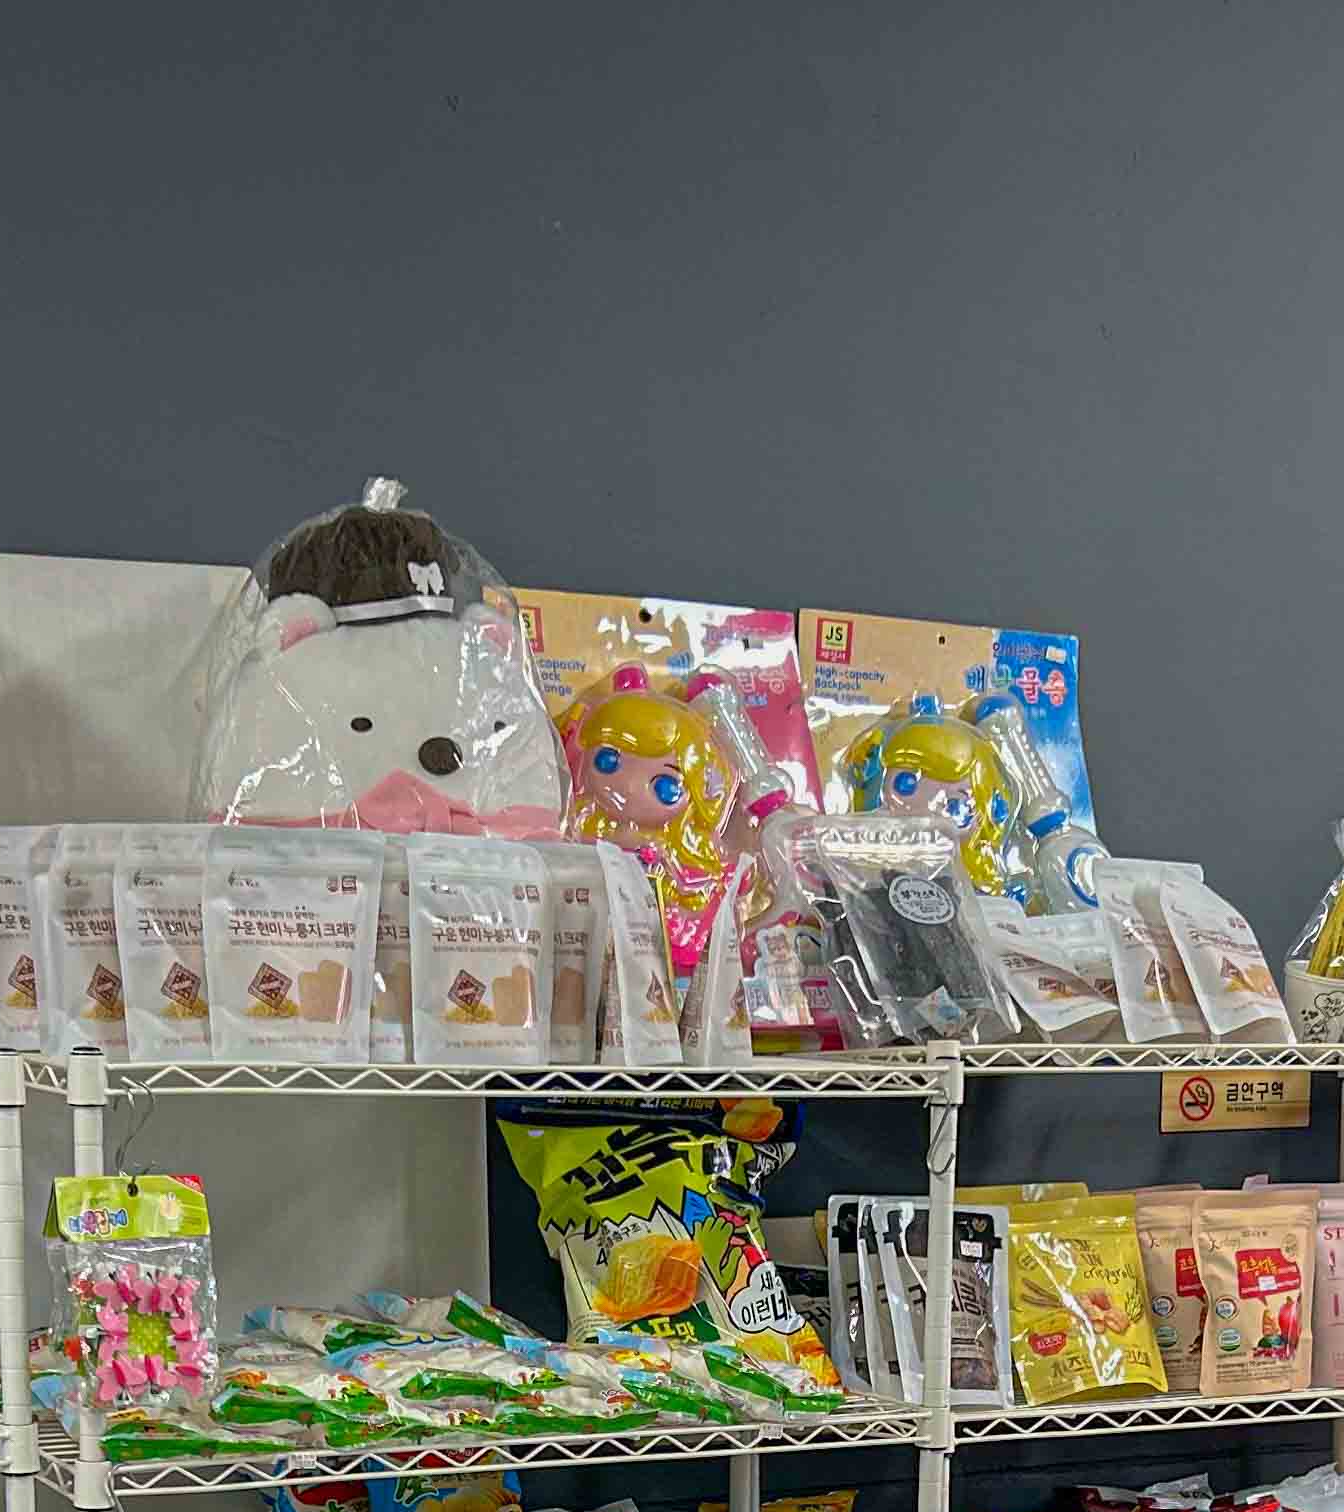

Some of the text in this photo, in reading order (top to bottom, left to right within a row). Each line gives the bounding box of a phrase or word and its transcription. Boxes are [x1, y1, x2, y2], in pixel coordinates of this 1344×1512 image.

[825, 626, 844, 640] JS
[231, 922, 255, 939] 구운
[257, 922, 282, 938] 현미
[283, 921, 321, 937] 누룽지
[432, 929, 457, 944] 구운
[459, 929, 485, 943] 현미
[1226, 1081, 1284, 1103] 금연구역
